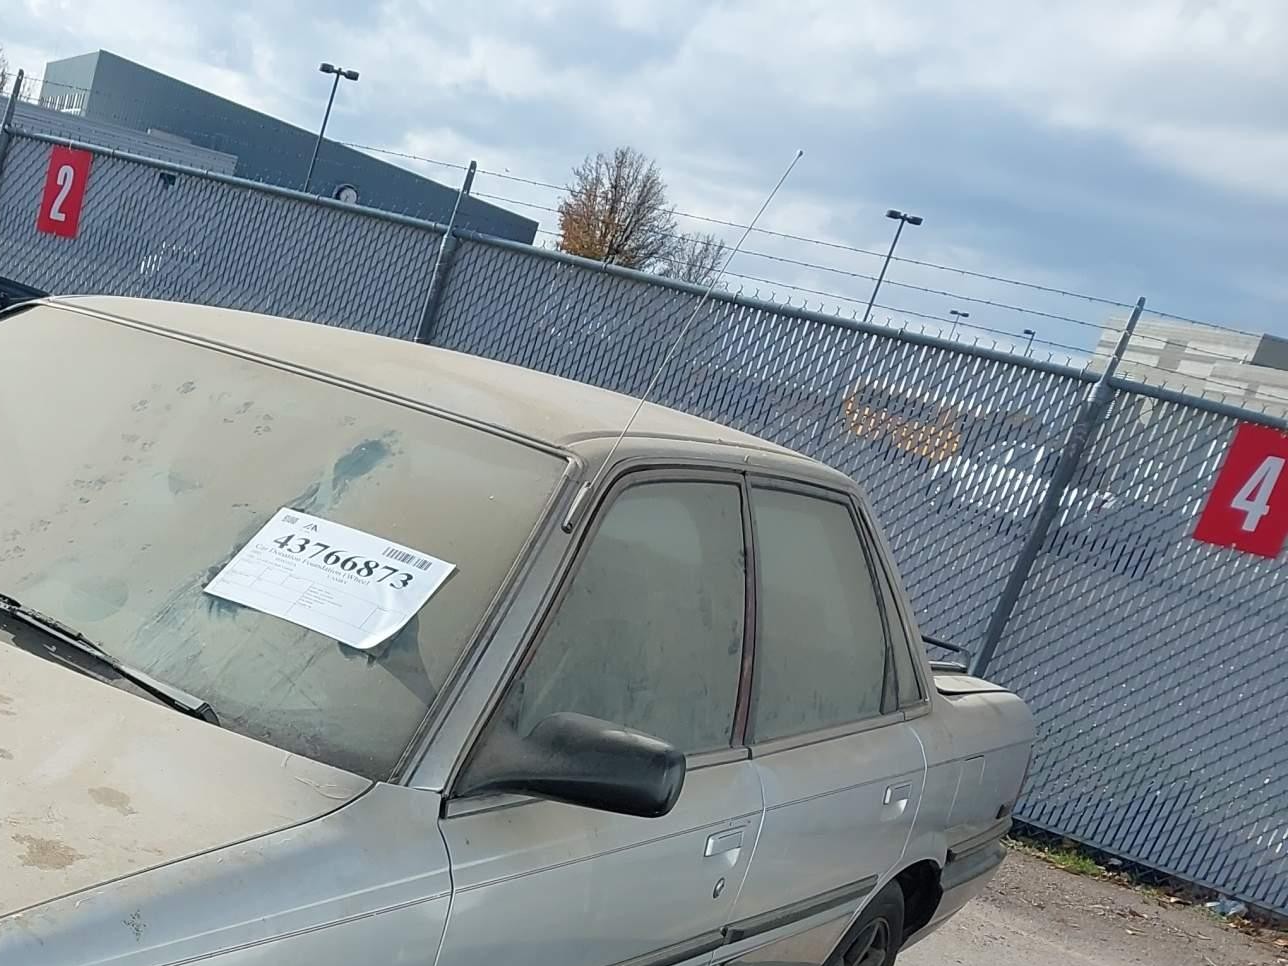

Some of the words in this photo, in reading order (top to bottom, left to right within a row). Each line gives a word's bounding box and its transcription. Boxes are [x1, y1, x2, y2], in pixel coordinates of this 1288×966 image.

[49, 165, 74, 222] 2
[1230, 455, 1286, 532] 4
[273, 533, 414, 590] 43766873
